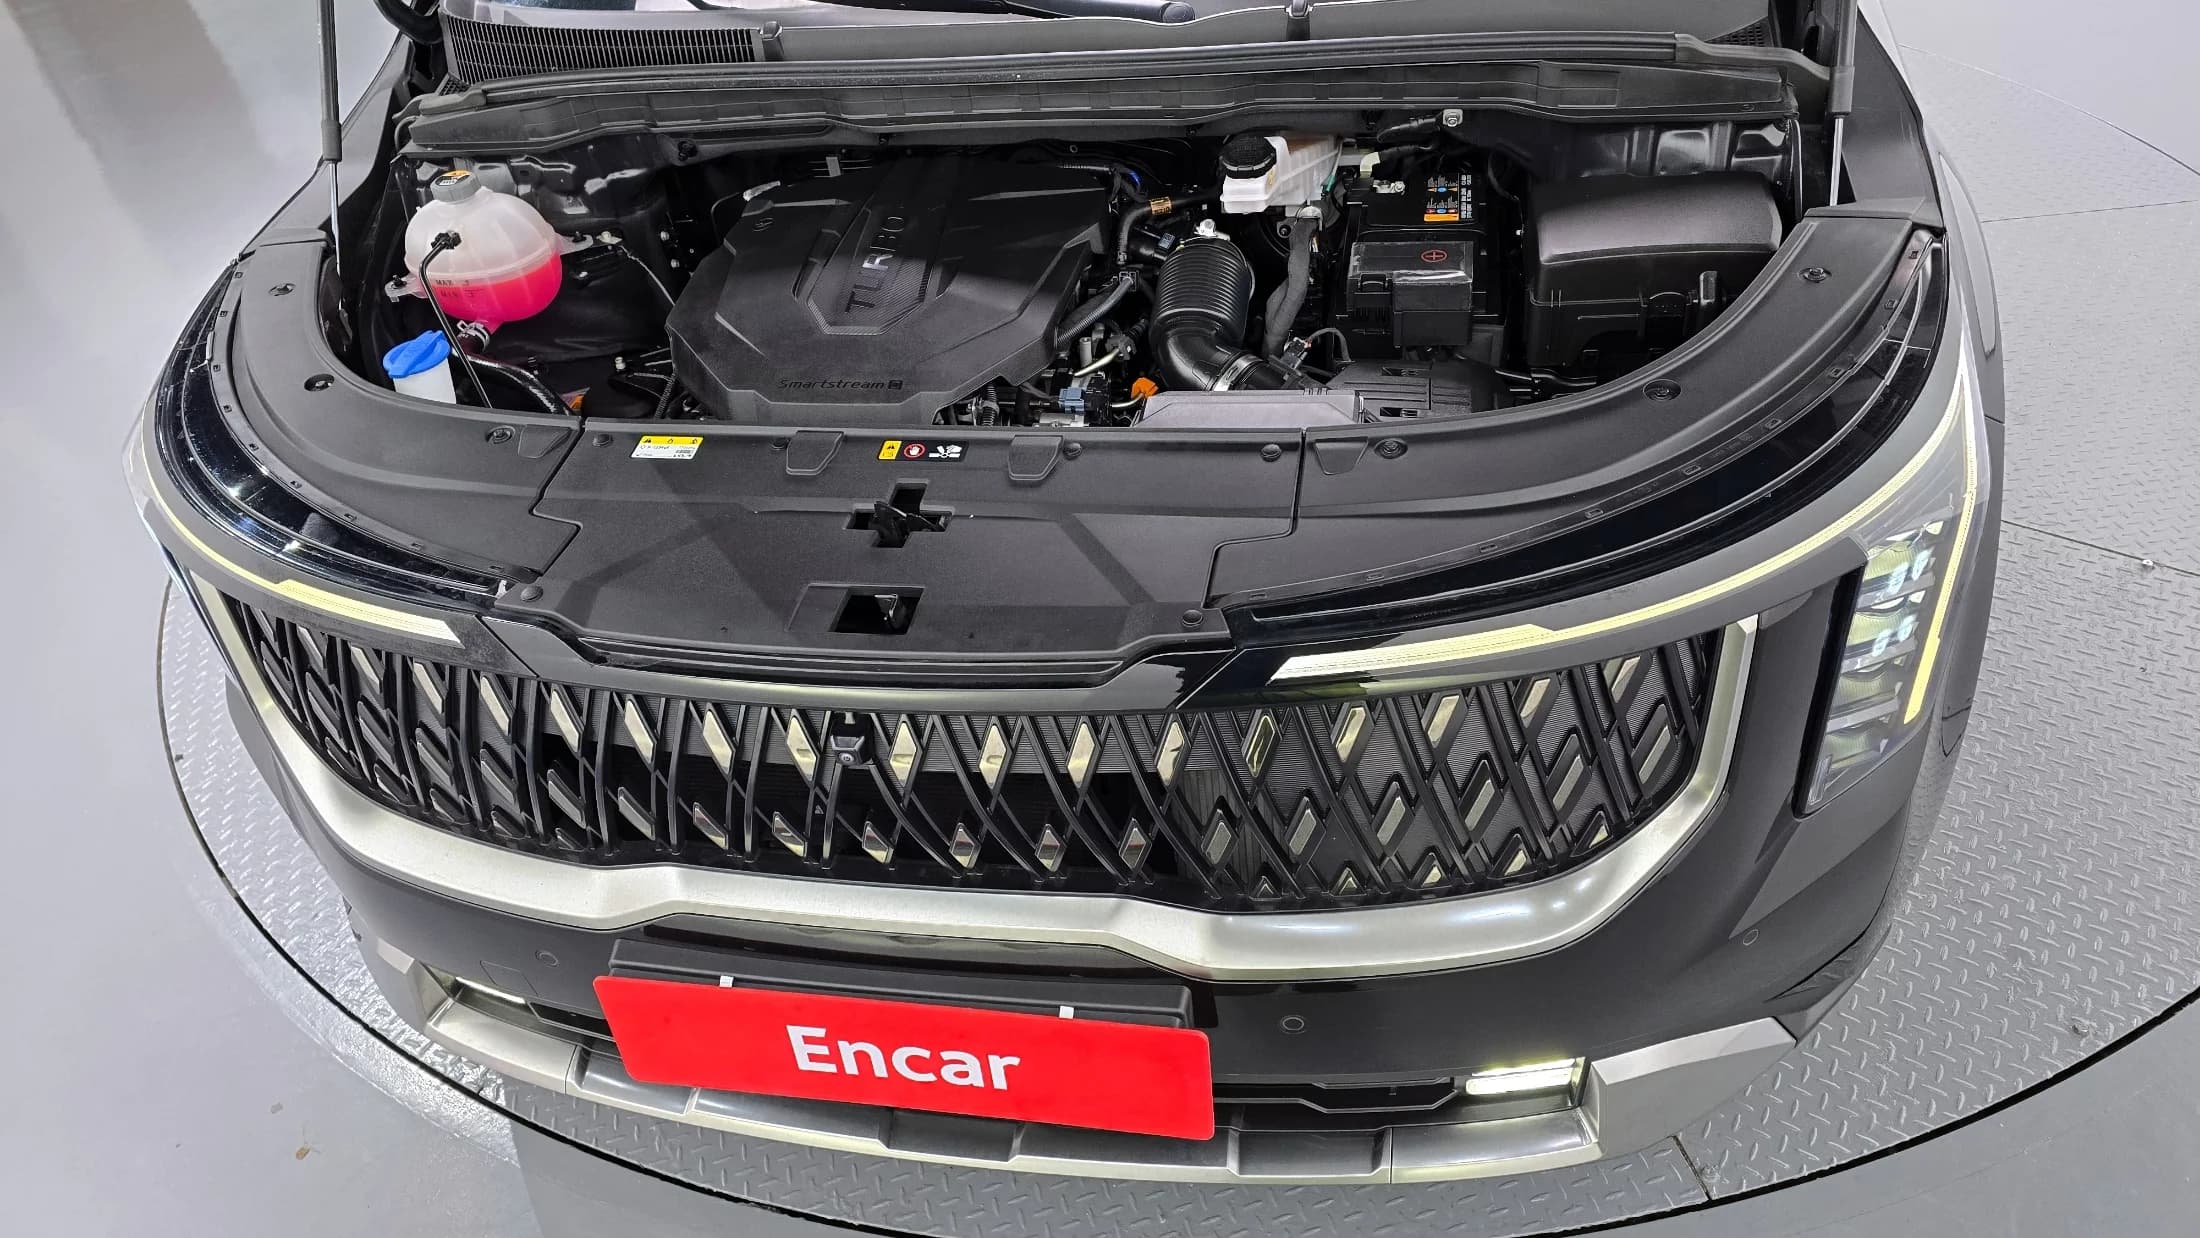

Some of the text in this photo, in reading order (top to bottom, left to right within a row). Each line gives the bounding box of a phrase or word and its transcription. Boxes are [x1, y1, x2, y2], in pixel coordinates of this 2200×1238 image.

[844, 216, 905, 313] TURBO
[778, 379, 885, 389] Smartstream
[786, 1024, 1021, 1091] Encar
